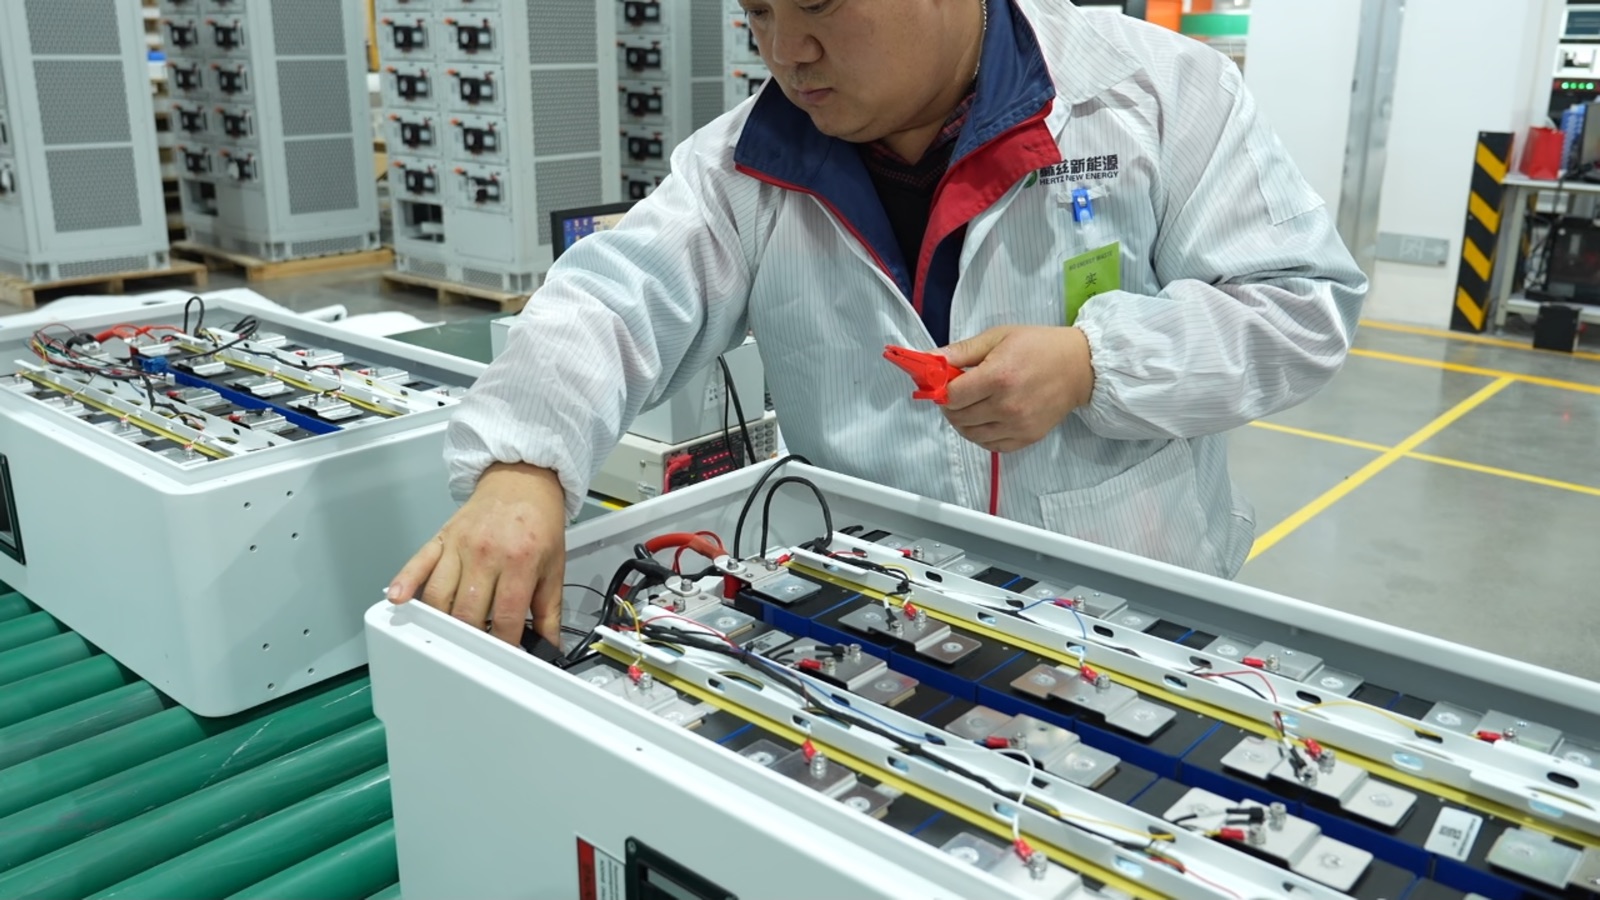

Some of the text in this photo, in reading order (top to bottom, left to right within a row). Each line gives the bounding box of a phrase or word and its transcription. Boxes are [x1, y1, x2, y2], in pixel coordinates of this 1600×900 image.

[1040, 171, 1119, 185] HERTZ NEW ENERGY
